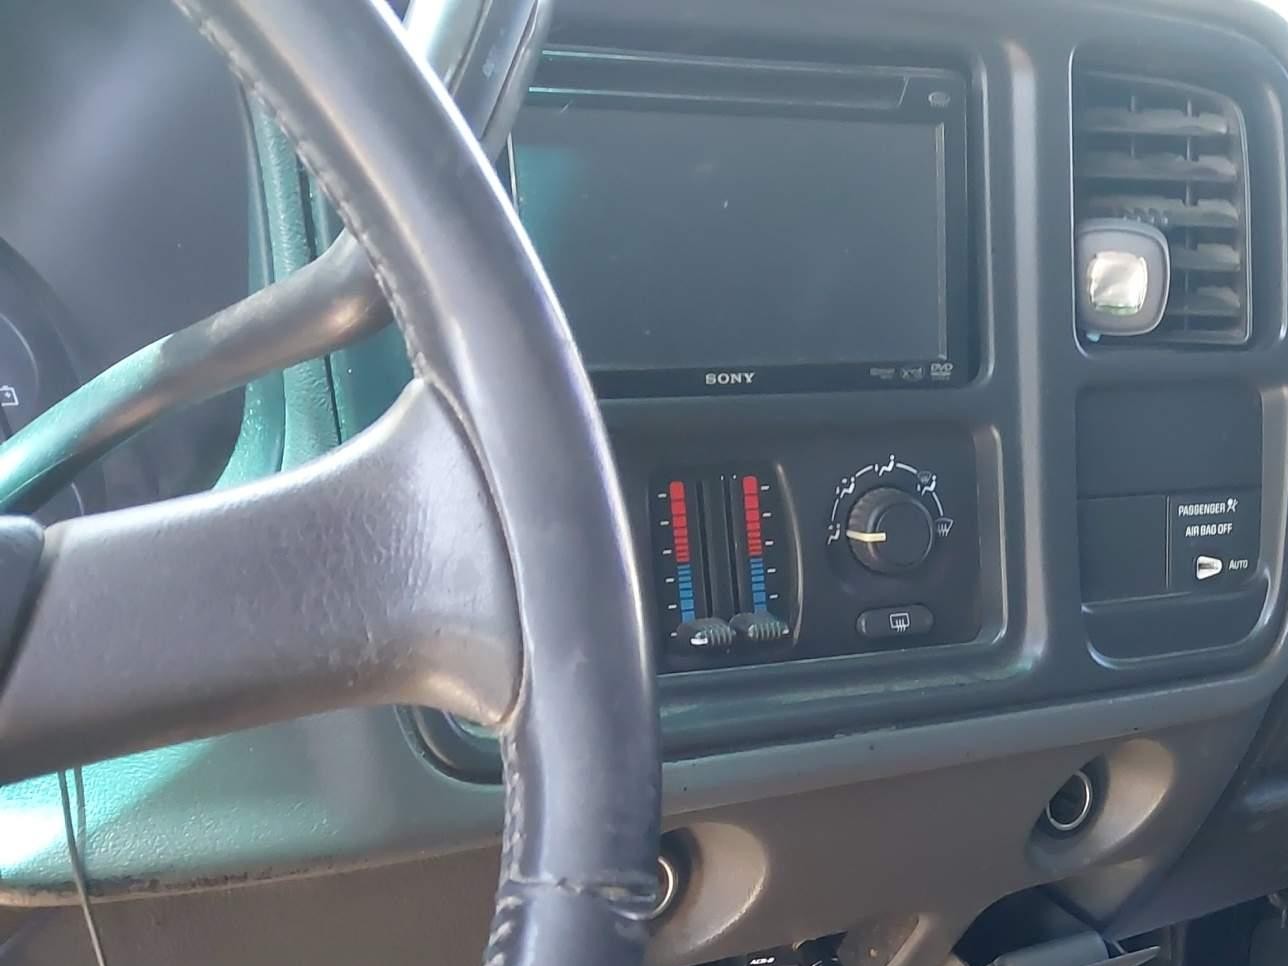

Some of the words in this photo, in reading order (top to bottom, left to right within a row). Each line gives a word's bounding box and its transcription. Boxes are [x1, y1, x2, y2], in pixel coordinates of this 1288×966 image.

[705, 372, 755, 385] SONY
[1178, 502, 1226, 516] PASSENGER
[1185, 525, 1199, 537] AIR
[1200, 524, 1217, 536] BAG
[1217, 523, 1233, 535] OFF
[1229, 559, 1248, 570] AUTO
